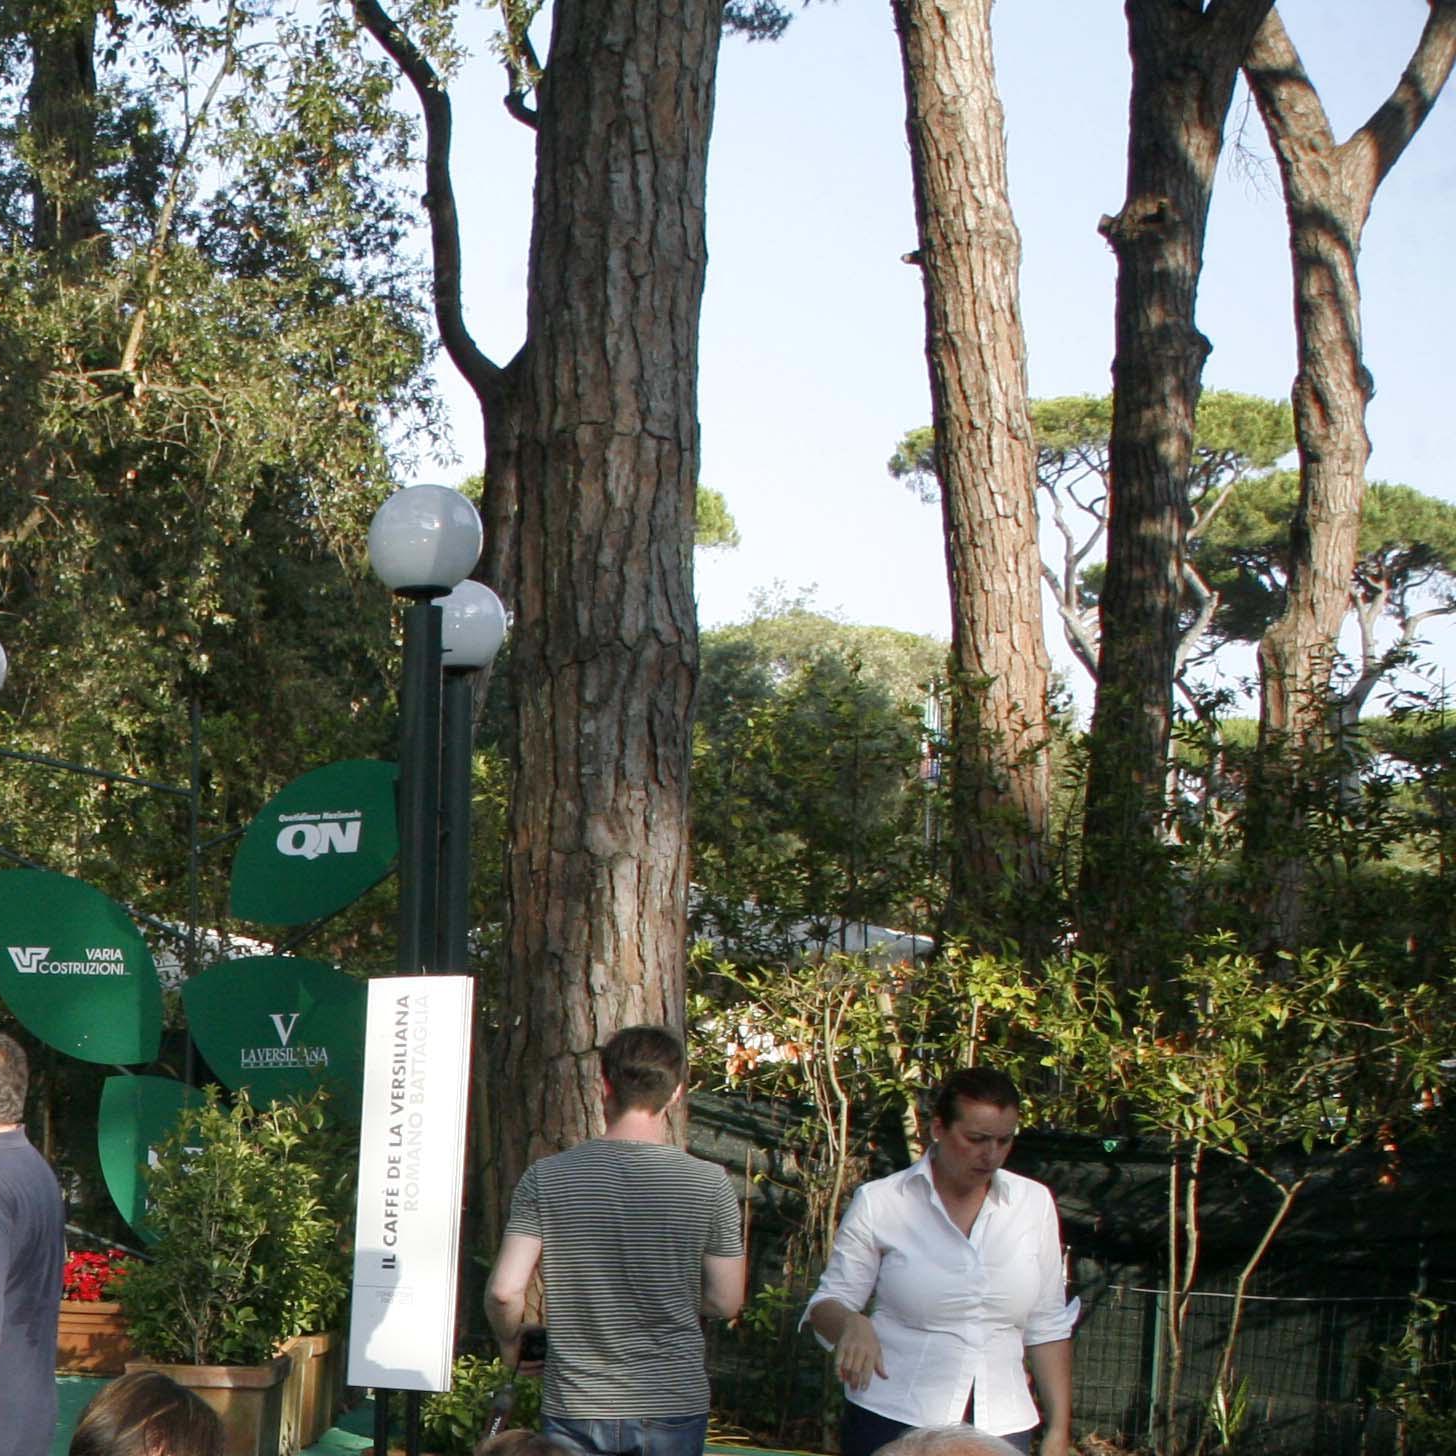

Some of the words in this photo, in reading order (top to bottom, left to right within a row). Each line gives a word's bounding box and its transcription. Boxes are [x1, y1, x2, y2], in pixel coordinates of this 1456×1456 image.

[276, 821, 361, 860] QN
[38, 961, 125, 975] COSTRUZIONI
[85, 948, 124, 961] VARIA
[390, 994, 410, 1116] VERSILIANA
[409, 993, 431, 1105] BATTAGLIA
[389, 1123, 403, 1148] LA
[387, 1156, 402, 1180] DE
[404, 1111, 424, 1212] ROMANO
[382, 1188, 400, 1247] CAFFÈ
[382, 1253, 397, 1270] IL
